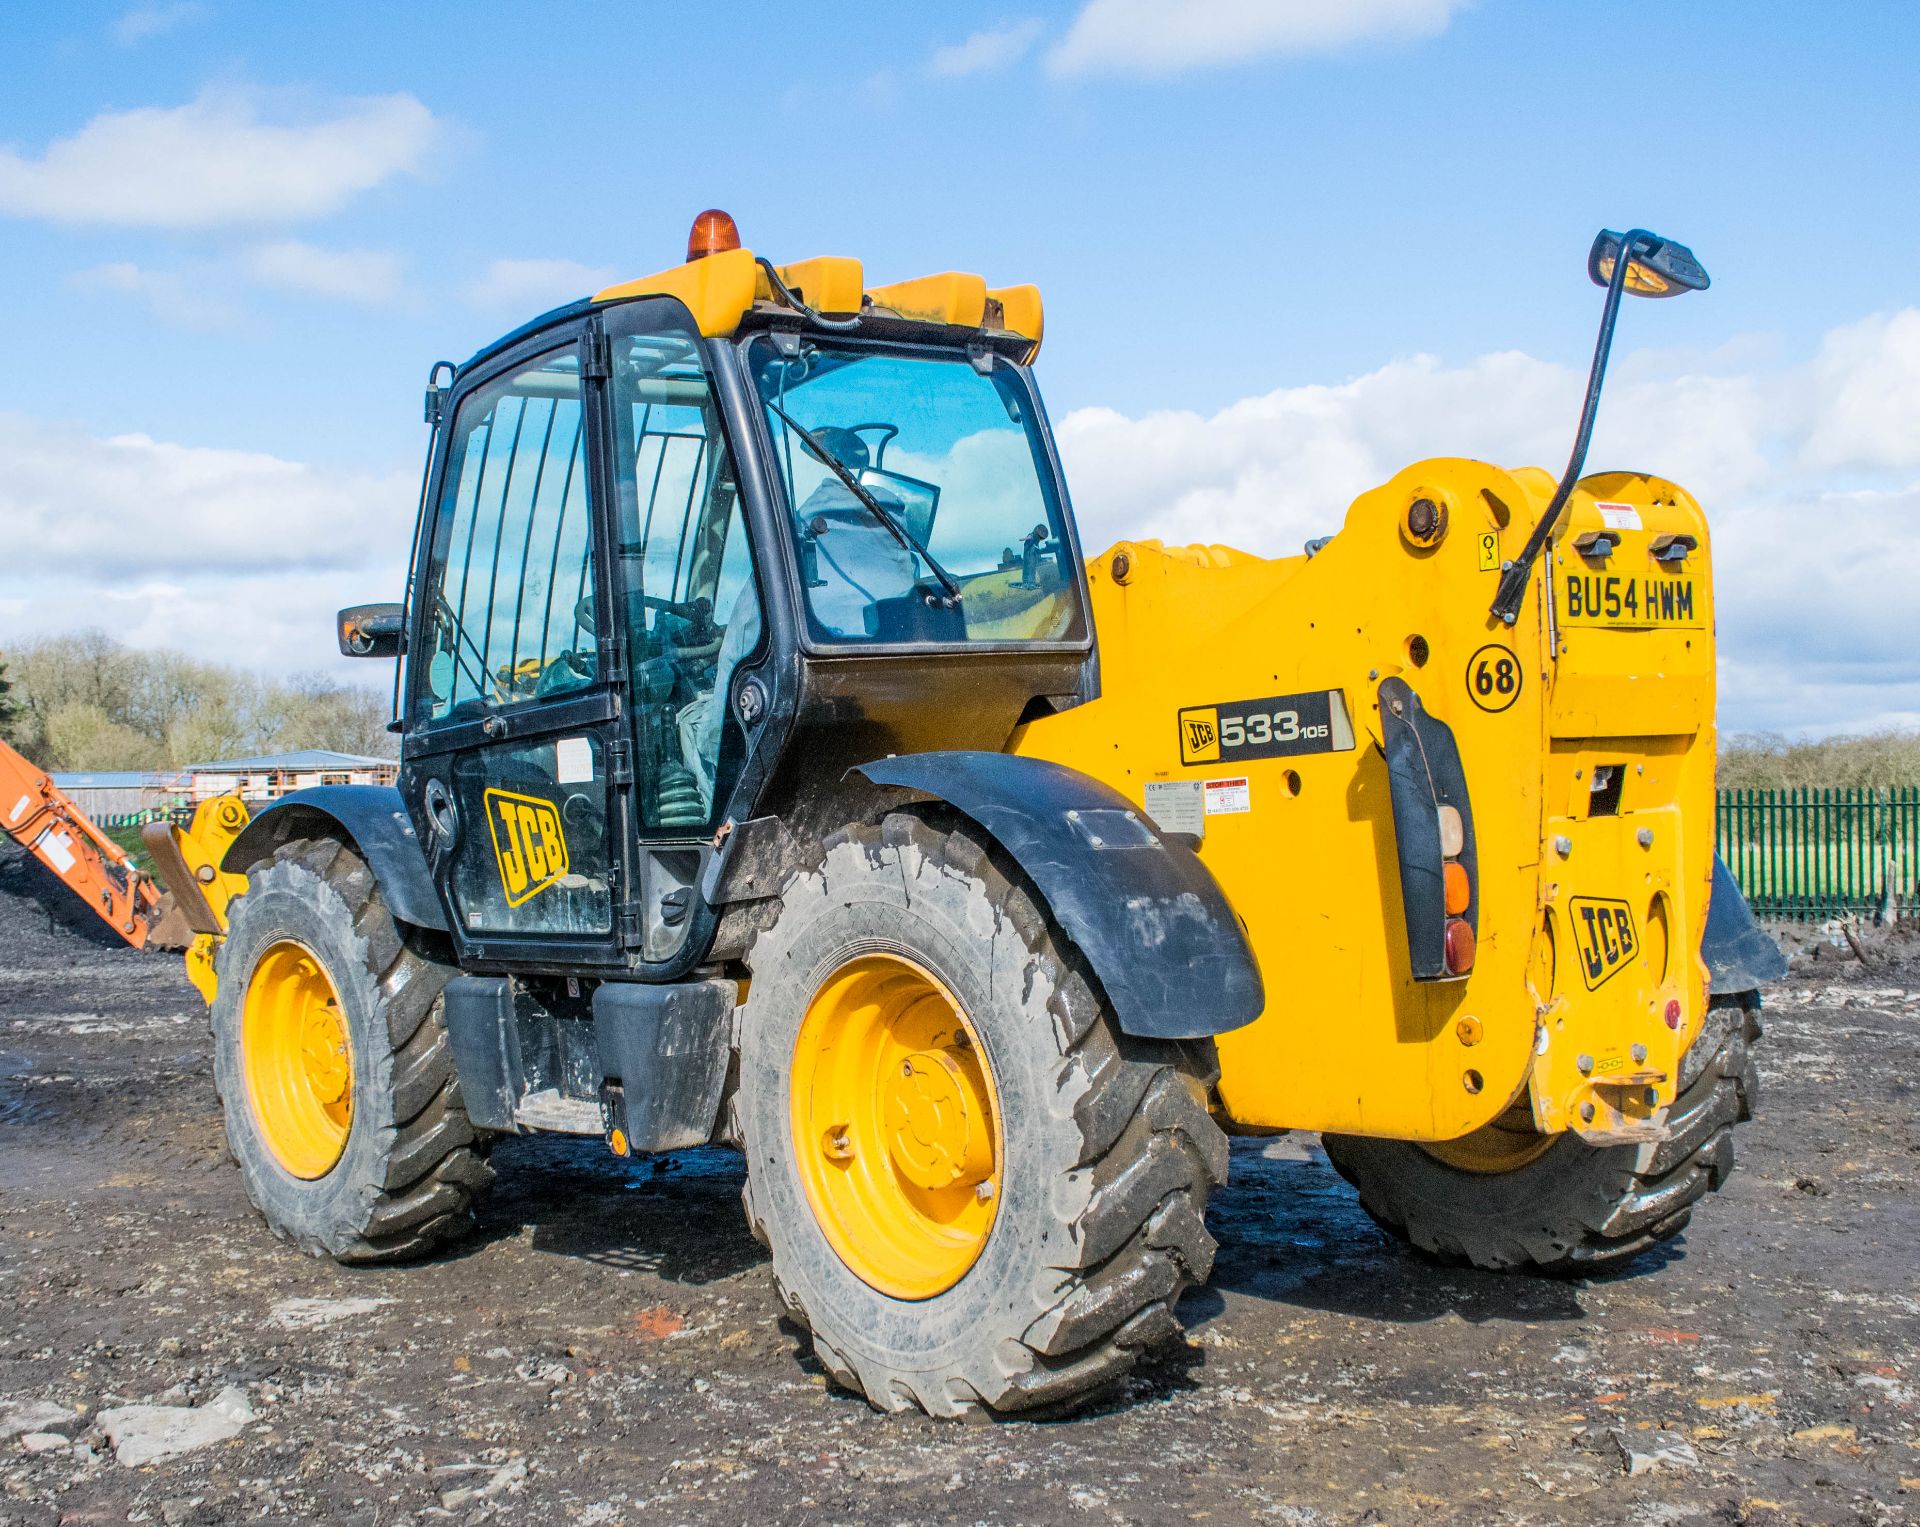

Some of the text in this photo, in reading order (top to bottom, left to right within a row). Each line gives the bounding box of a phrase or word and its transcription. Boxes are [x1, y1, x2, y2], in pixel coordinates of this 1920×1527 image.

[1566, 575, 1694, 621] BU54 HWM
[1476, 658, 1515, 696] 68
[1189, 723, 1214, 749] JCB
[1220, 710, 1329, 747] 533 105
[498, 800, 563, 894] JCB
[1580, 906, 1633, 980] JCB
